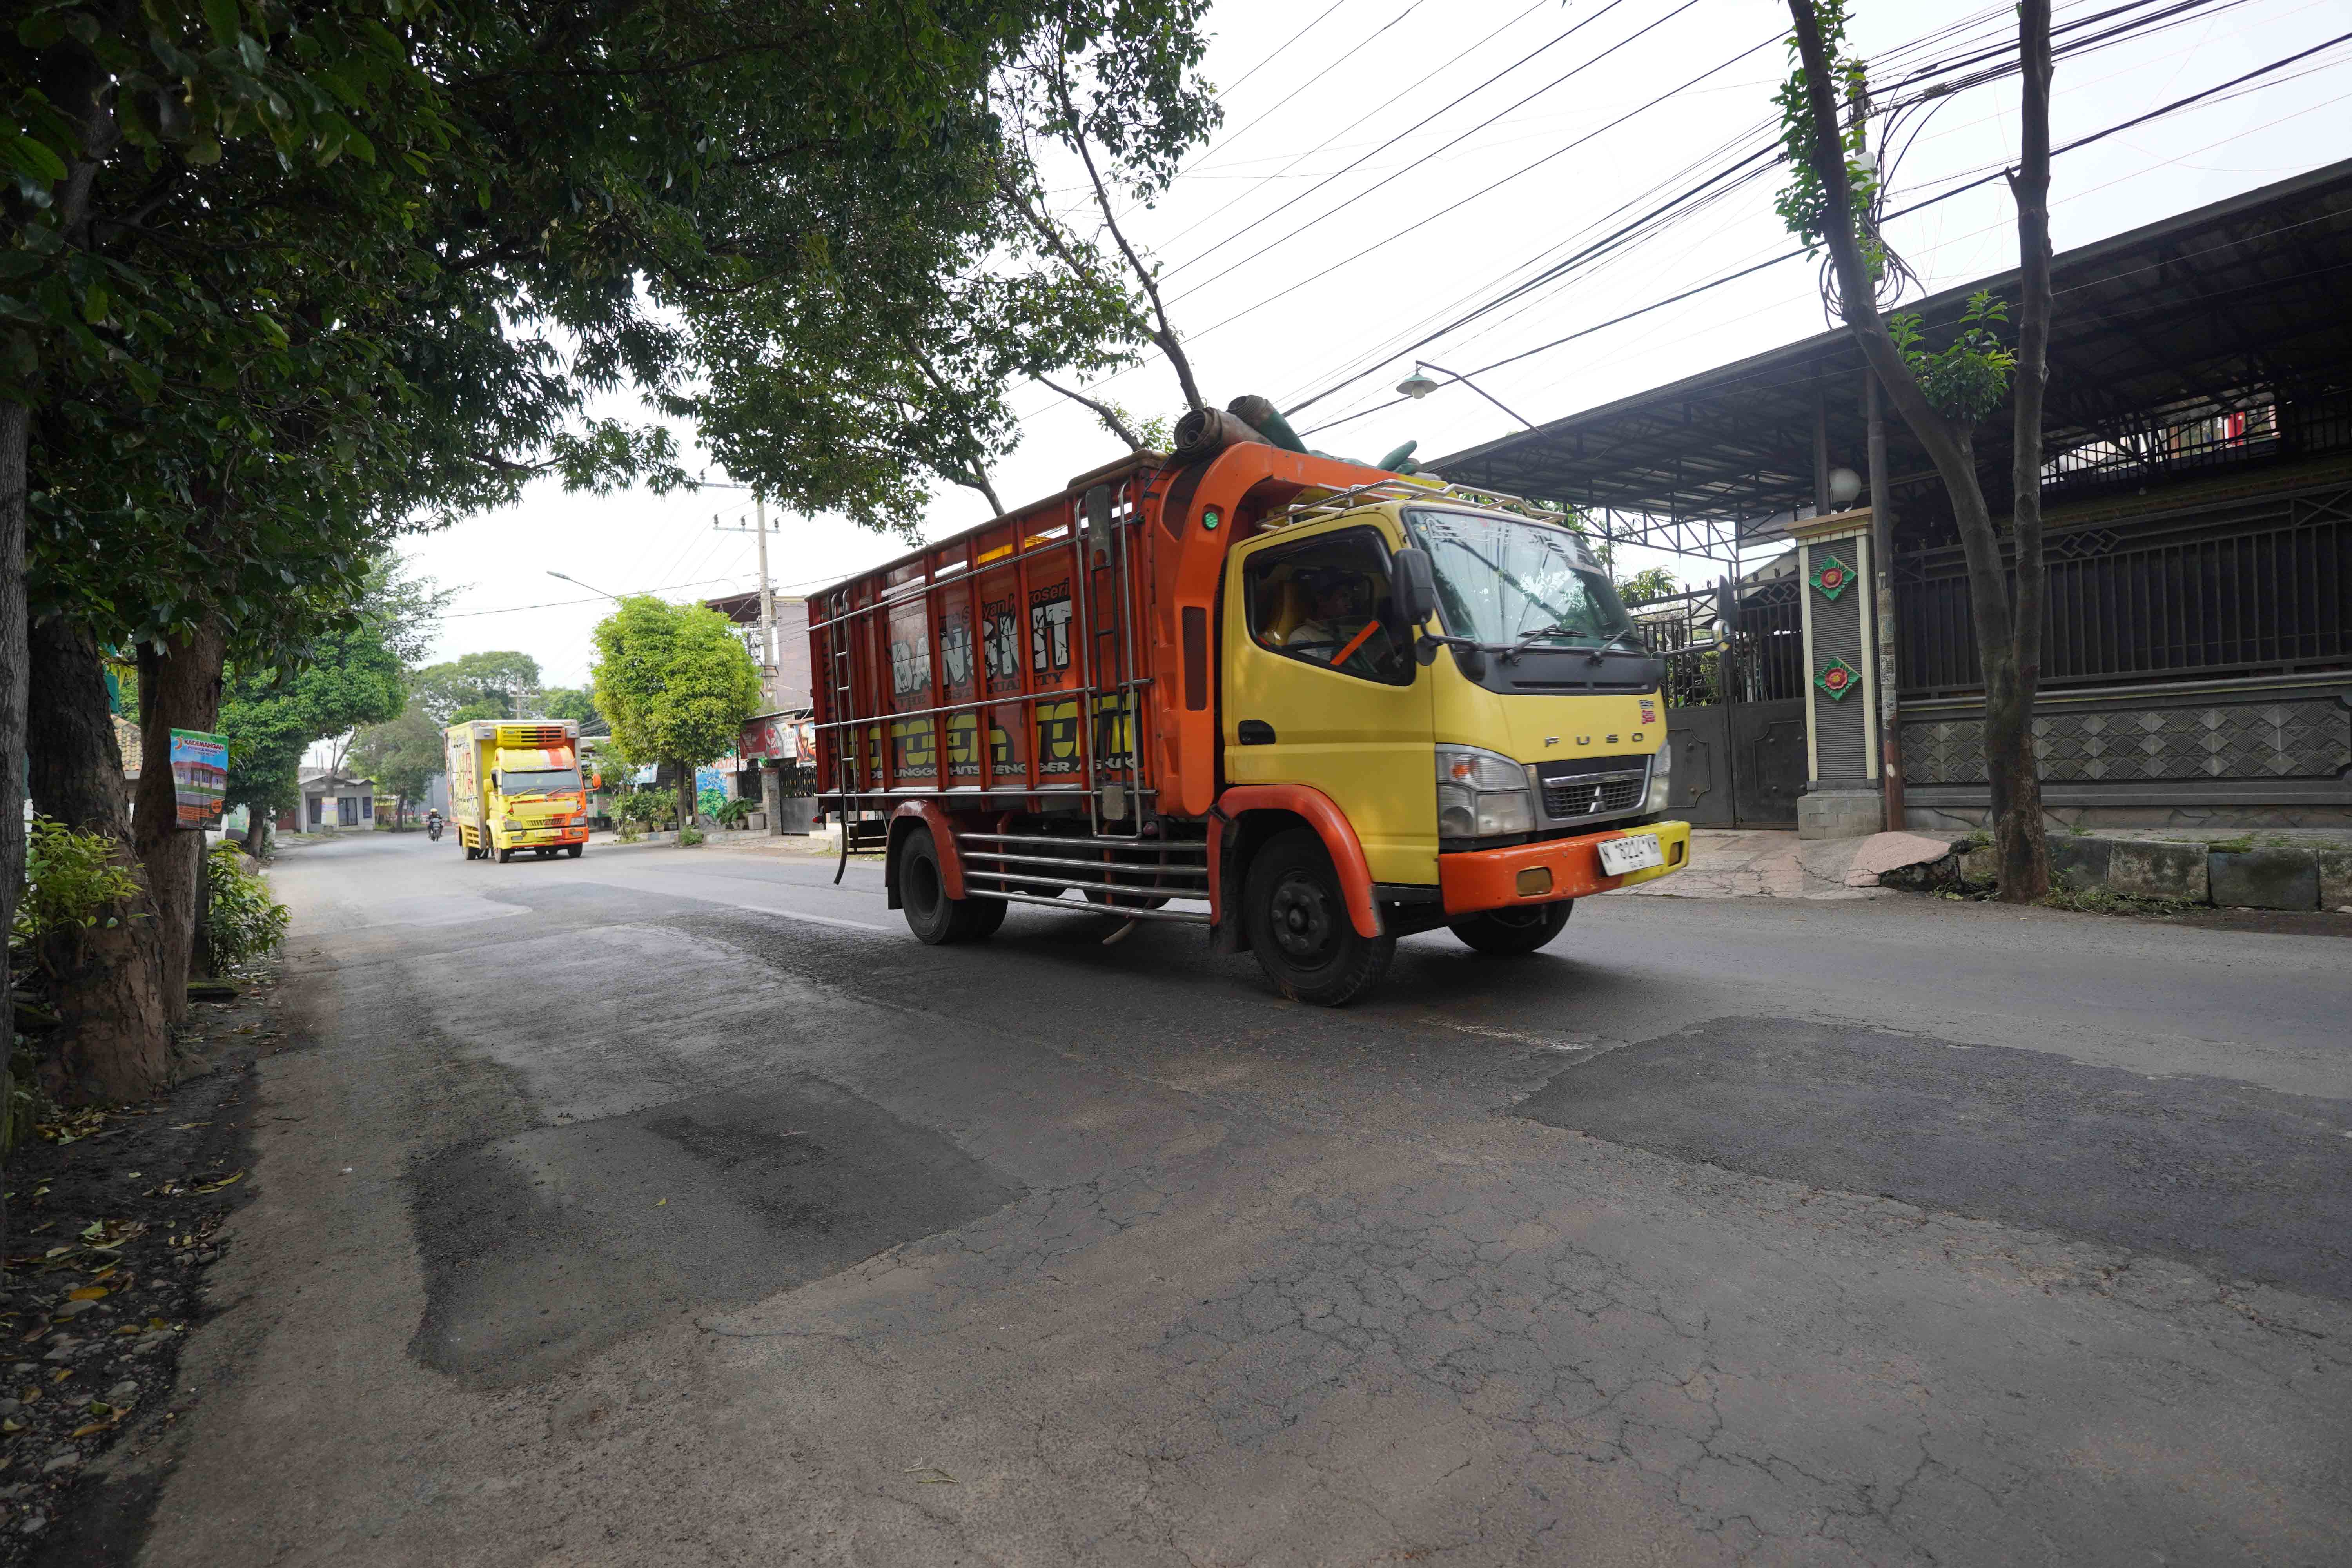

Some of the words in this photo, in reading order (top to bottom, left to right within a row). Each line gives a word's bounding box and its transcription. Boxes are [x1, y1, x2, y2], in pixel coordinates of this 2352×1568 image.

[1008, 577, 1070, 616] Kroseri
[897, 695, 926, 708] THE
[940, 688, 973, 701] EST
[985, 671, 1065, 694] UATY
[184, 739, 224, 750] KADEMANGAN
[1545, 732, 1644, 748] FUSO
